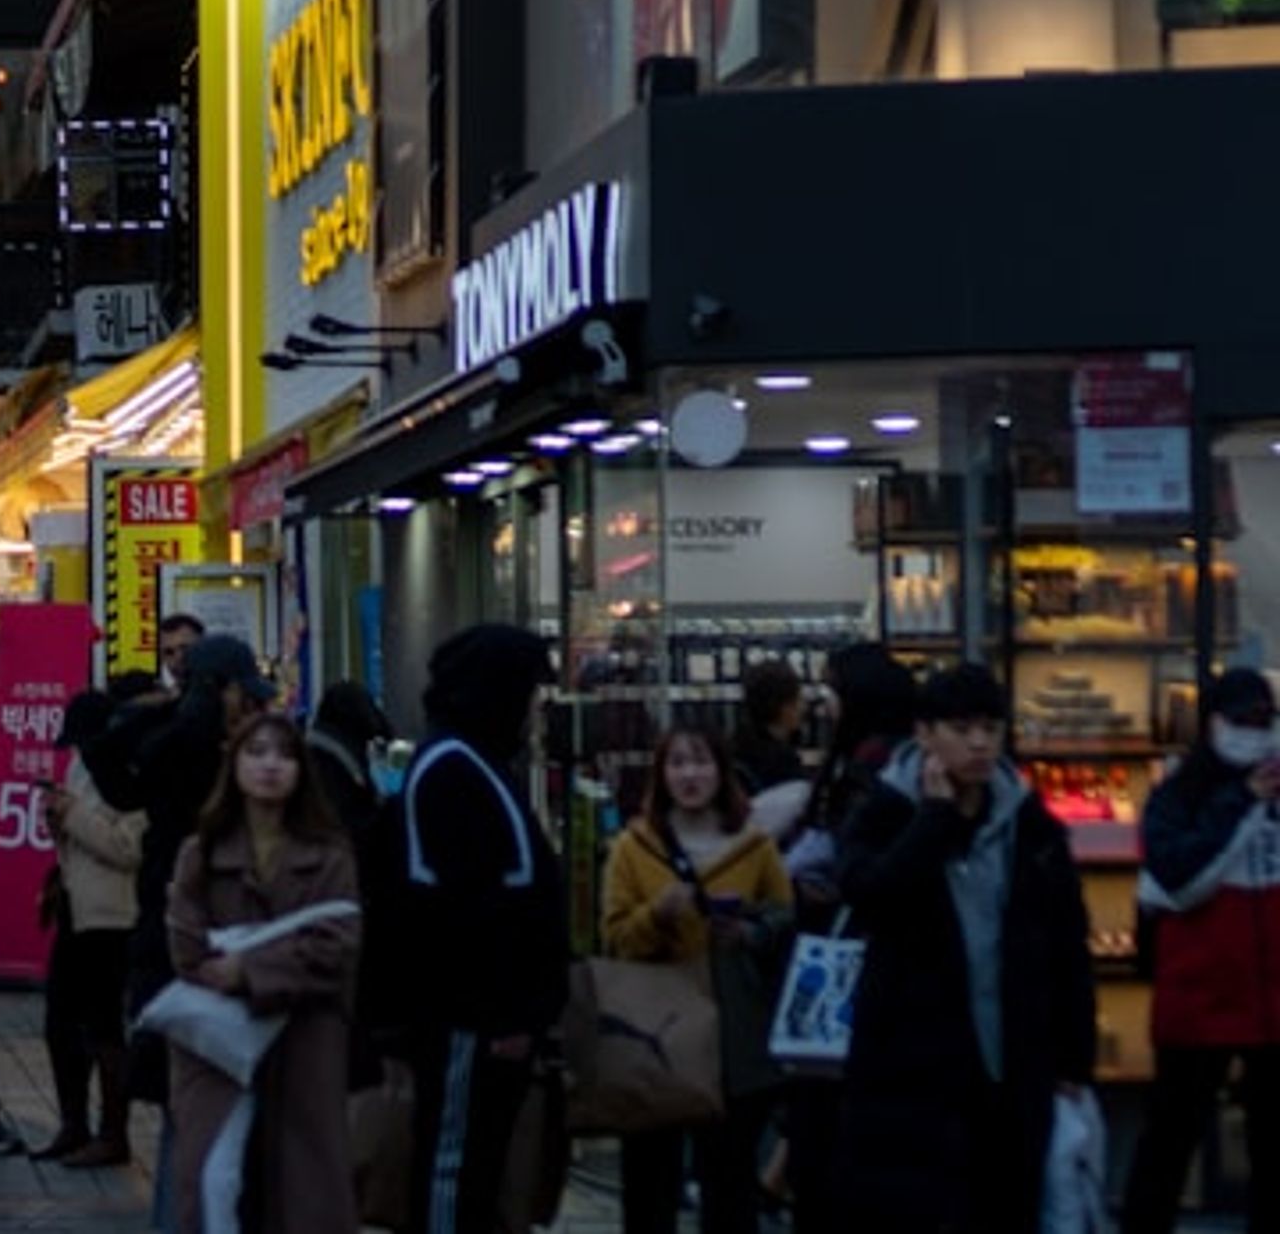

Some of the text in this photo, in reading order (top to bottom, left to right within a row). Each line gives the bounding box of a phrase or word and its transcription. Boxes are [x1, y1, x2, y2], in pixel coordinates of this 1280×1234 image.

[452, 184, 598, 372] TONYMOLY
[93, 290, 157, 348] 헤나
[128, 483, 188, 522] SALE
